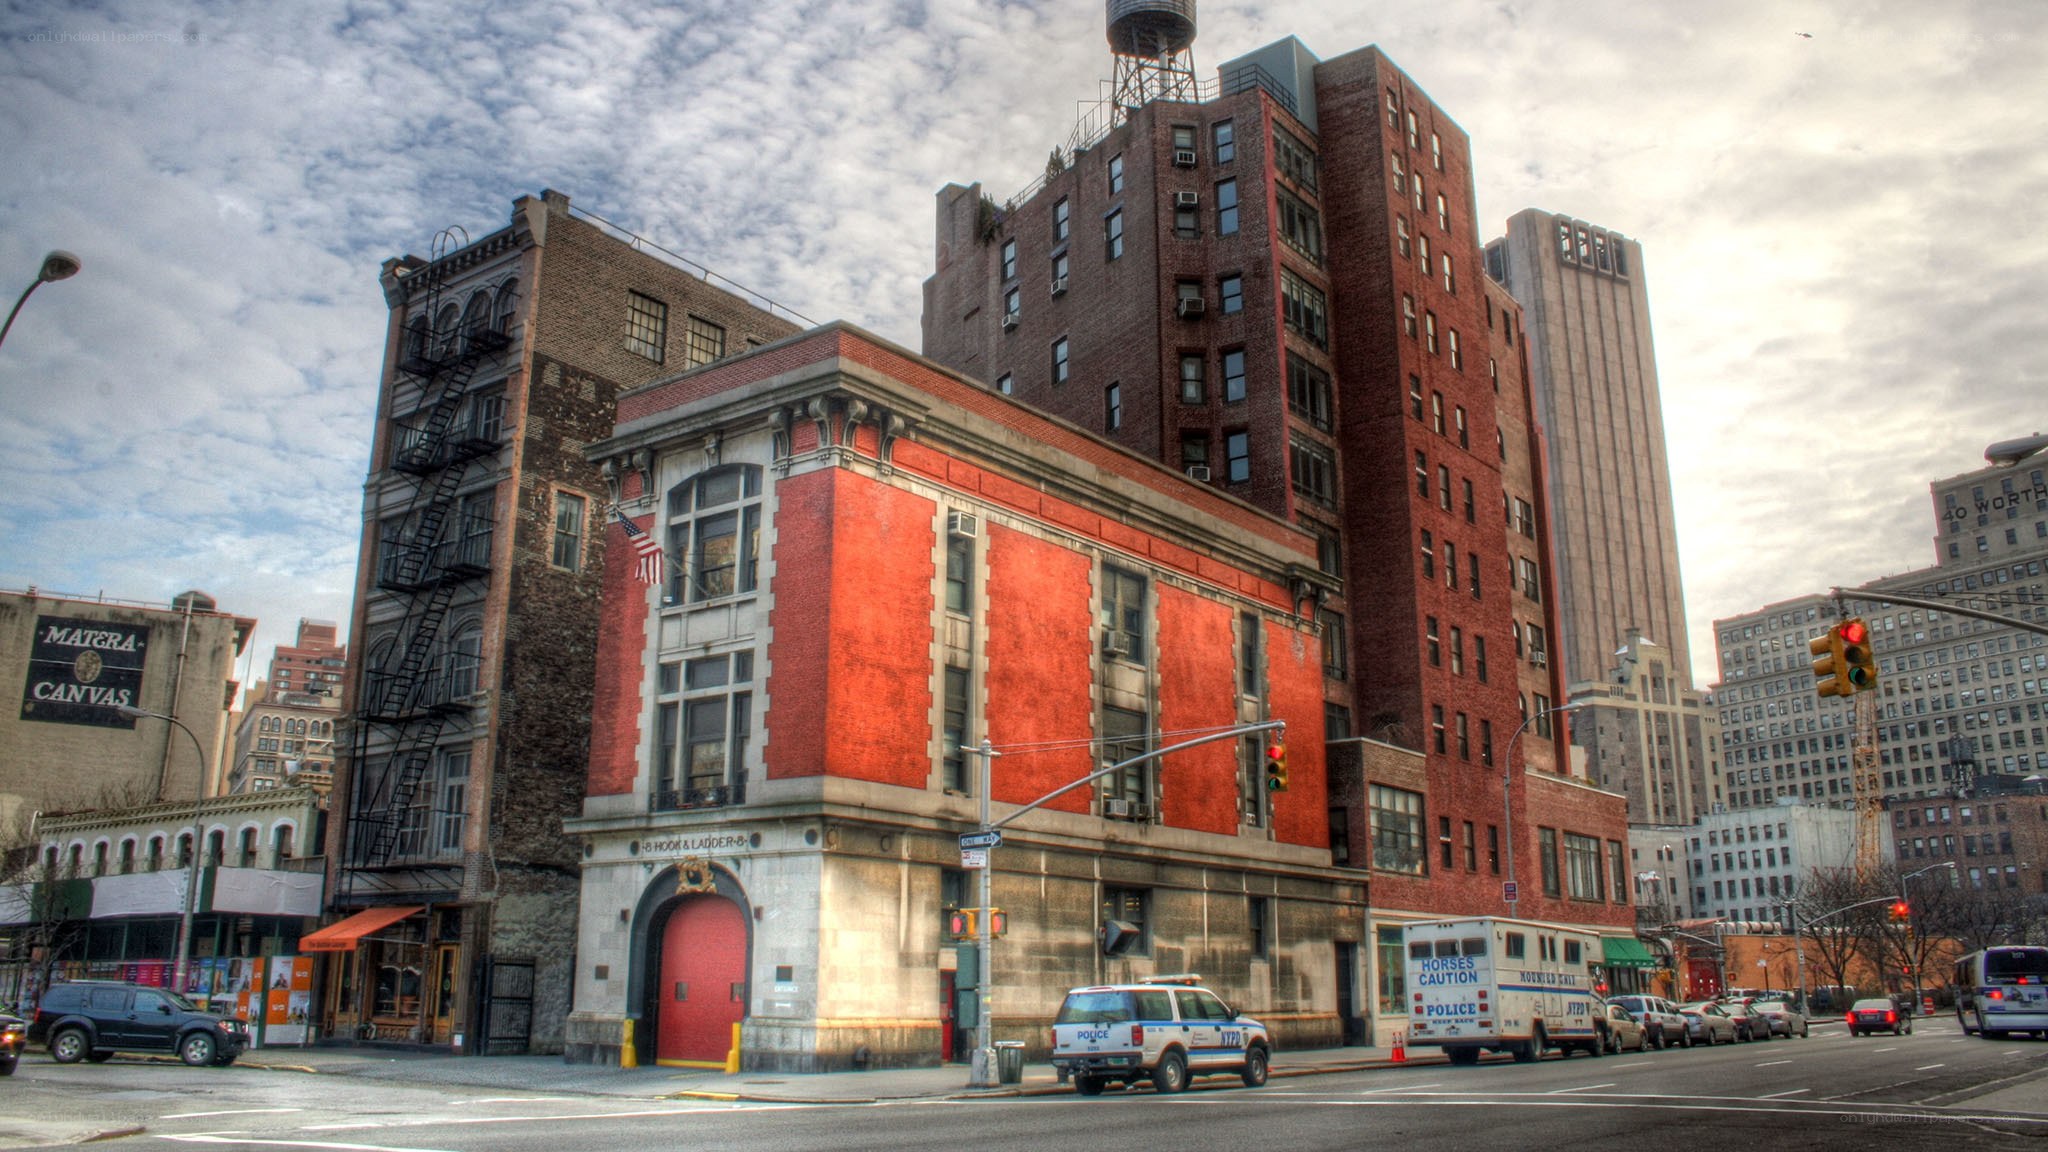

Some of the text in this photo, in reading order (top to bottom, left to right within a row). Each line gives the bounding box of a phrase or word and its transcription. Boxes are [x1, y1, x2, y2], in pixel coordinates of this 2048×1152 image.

[1942, 485, 2048, 521] 40 WORTH
[43, 626, 136, 651] MATERA
[33, 682, 131, 708] CANVAS
[654, 840, 681, 852] HOOK
[683, 840, 689, 850] &
[962, 838, 975, 846] ONE
[1421, 956, 1475, 972] HORSES
[1419, 971, 1478, 986] CAUTION
[1427, 1003, 1477, 1017] POLICE
[1077, 1030, 1109, 1040] POLICE
[1221, 1031, 1240, 1046] NYPD
